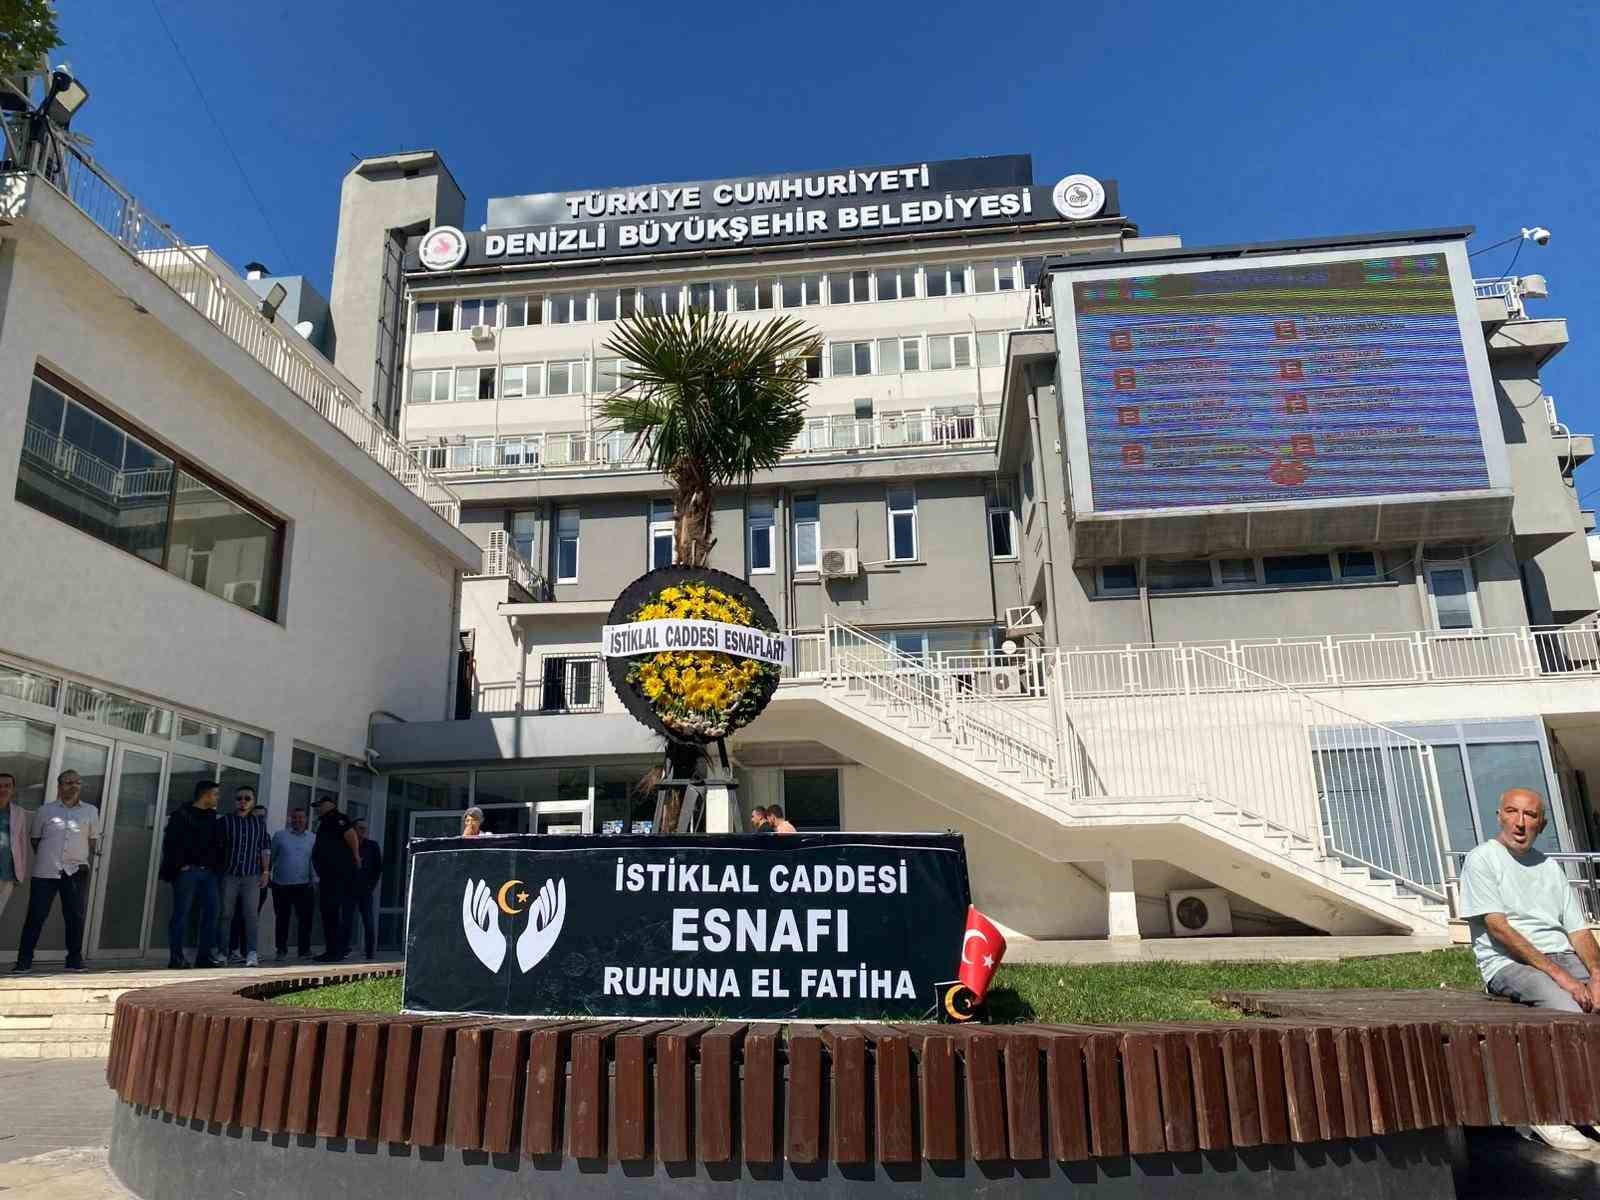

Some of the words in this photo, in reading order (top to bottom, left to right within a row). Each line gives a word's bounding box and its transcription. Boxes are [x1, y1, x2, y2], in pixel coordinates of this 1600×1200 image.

[566, 187, 700, 218] TÜRKİYE
[713, 164, 929, 205] CUMHURİYETİ
[486, 223, 606, 256] DENİZLİ
[619, 207, 828, 247] BÜYÜKŞEHİR
[839, 187, 1032, 229] BELEDİYESİ
[610, 625, 659, 653] İSTİKLAL
[665, 624, 718, 647] CADDESİ
[724, 629, 784, 662] ESNAFLARI
[615, 857, 759, 894] İSTİKLAL
[769, 859, 908, 894] CADDESİ
[671, 908, 848, 953] ESNAFI
[603, 967, 742, 998] RUHUNA
[752, 968, 790, 998] EL
[801, 962, 917, 999] FATİHA
